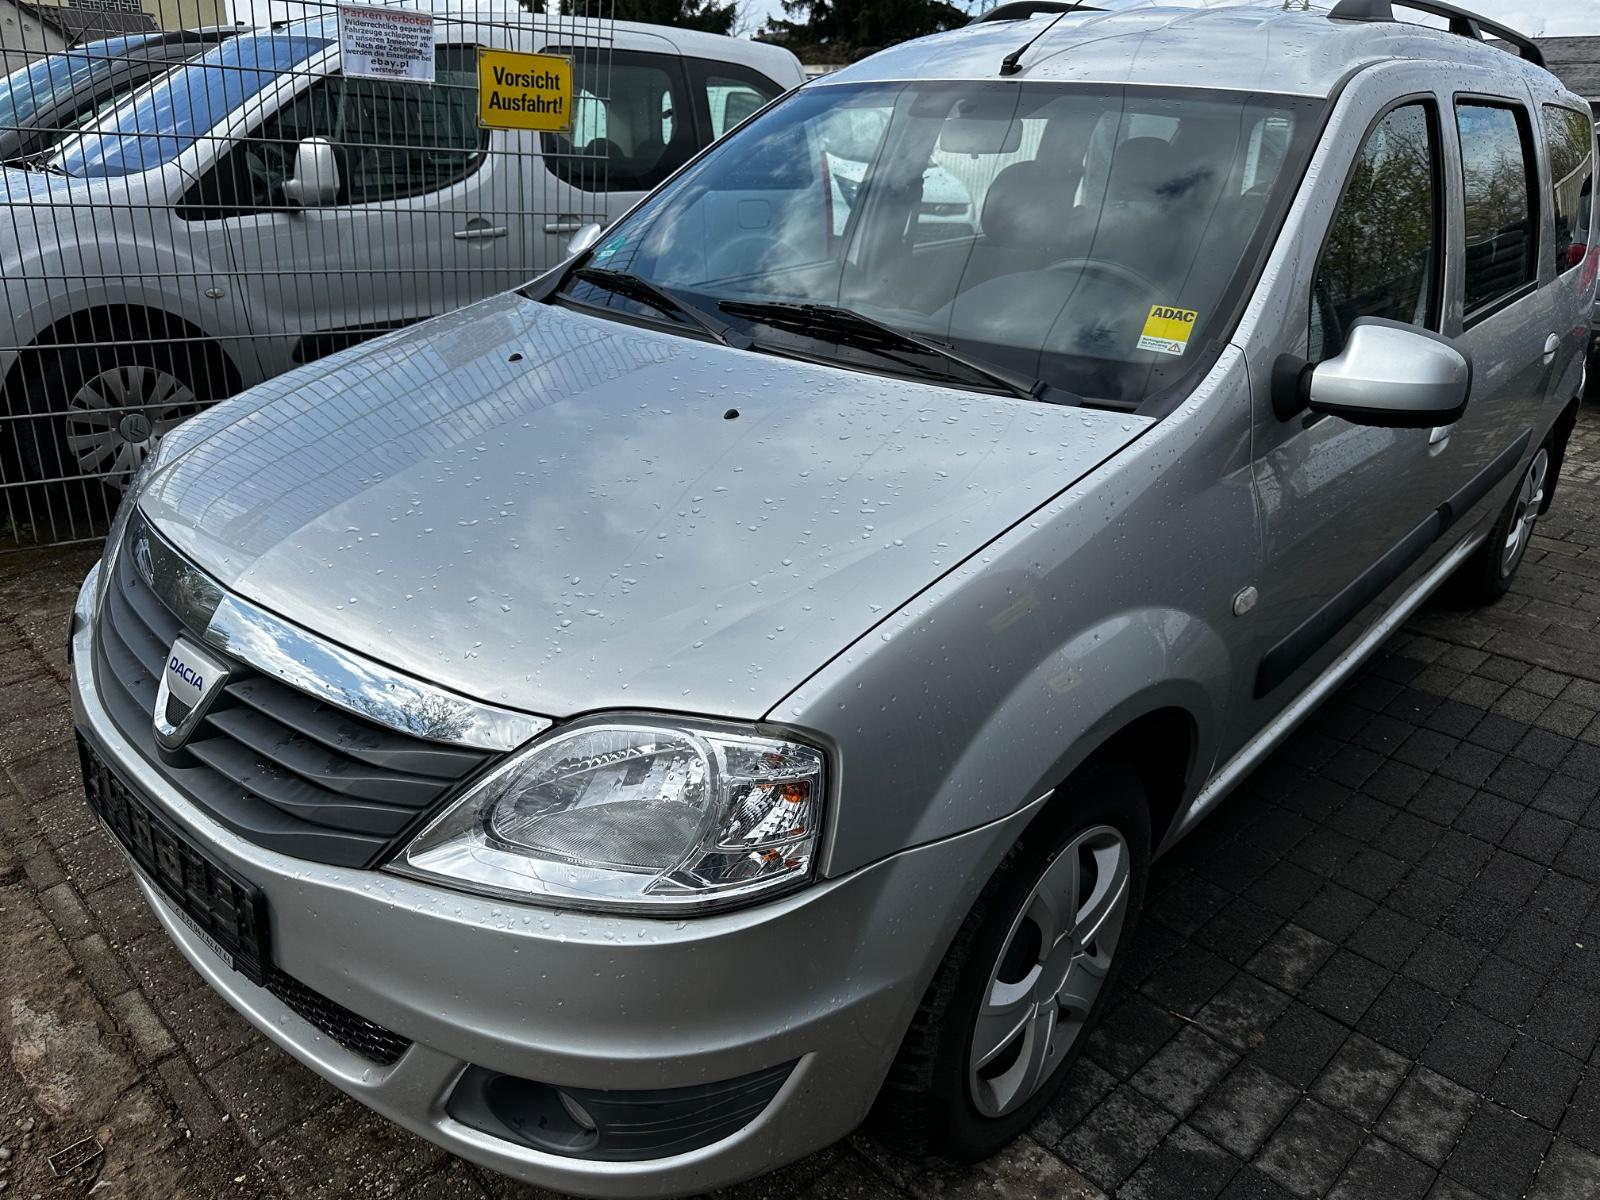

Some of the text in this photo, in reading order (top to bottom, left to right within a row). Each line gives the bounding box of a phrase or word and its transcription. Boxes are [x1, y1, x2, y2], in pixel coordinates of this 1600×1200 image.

[343, 8, 432, 26] Parken verboten
[345, 18, 431, 34] Widerrechtlich geparkte
[345, 26, 383, 36] Fahrzeuge
[384, 31, 419, 41] schleppen
[355, 35, 385, 44] unseren
[386, 38, 418, 47] Innenhof
[355, 42, 373, 50] Nach
[388, 45, 423, 55] Zerlegung
[345, 48, 373, 56] werden
[386, 52, 420, 61] Einzelteile
[371, 58, 409, 67] ebay.pl
[371, 66, 409, 75] versteigert.
[493, 66, 560, 90] Vorsicht
[489, 91, 563, 114] Ausfahrt!
[1152, 307, 1195, 322] ADAC
[169, 656, 203, 691] DACIA
